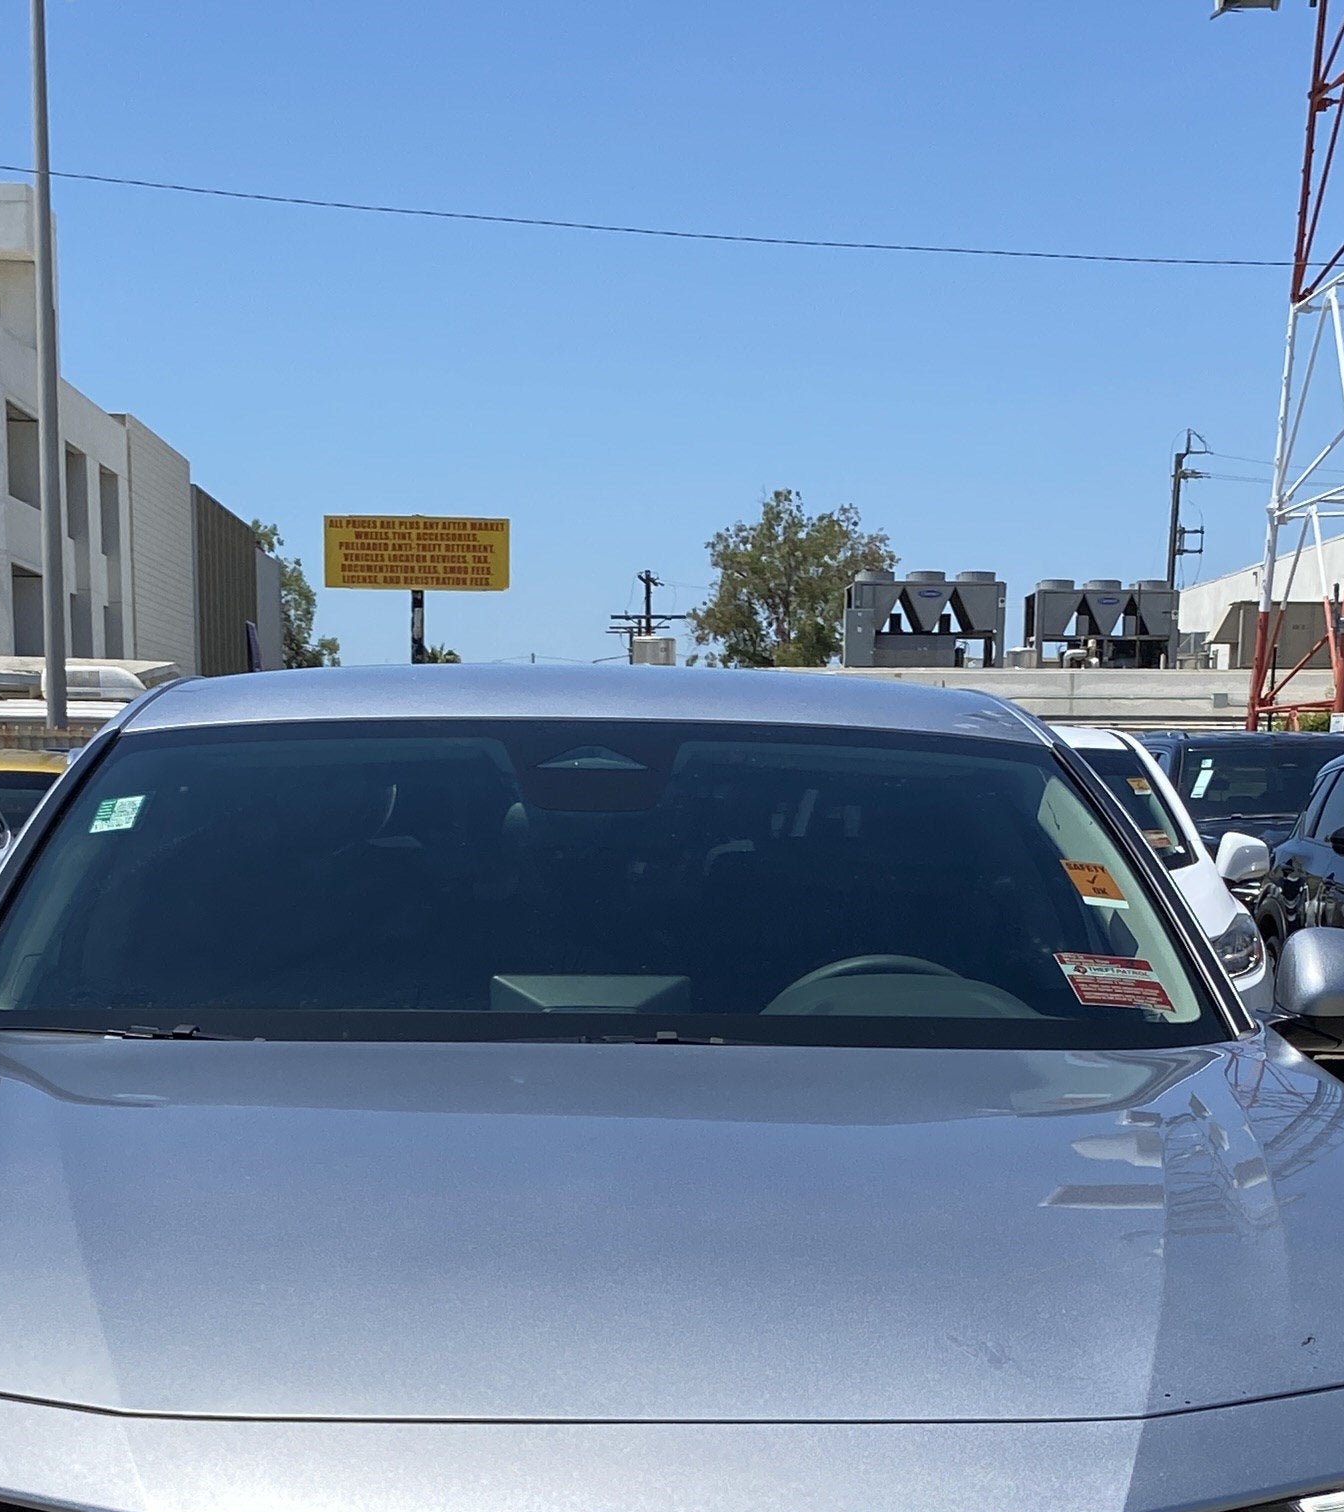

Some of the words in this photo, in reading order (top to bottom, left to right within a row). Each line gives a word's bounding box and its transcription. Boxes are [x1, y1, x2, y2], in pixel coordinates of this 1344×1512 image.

[329, 519, 343, 528] ALL
[345, 519, 377, 529] PRICES
[380, 520, 396, 529] ARE
[399, 520, 420, 529] PLUS
[423, 521, 439, 530] ANY
[442, 521, 467, 531] AFTER
[470, 522, 504, 532] MARKET
[343, 552, 385, 562] VEHICLES
[388, 553, 427, 563] LOCATOR
[341, 563, 416, 573] DOCUMENTATION
[443, 566, 468, 575] SMOG
[383, 575, 401, 584] AND
[404, 575, 467, 586] REGISTRATION
[1065, 862, 1106, 874] SAFETY
[1091, 887, 1109, 895] OK
